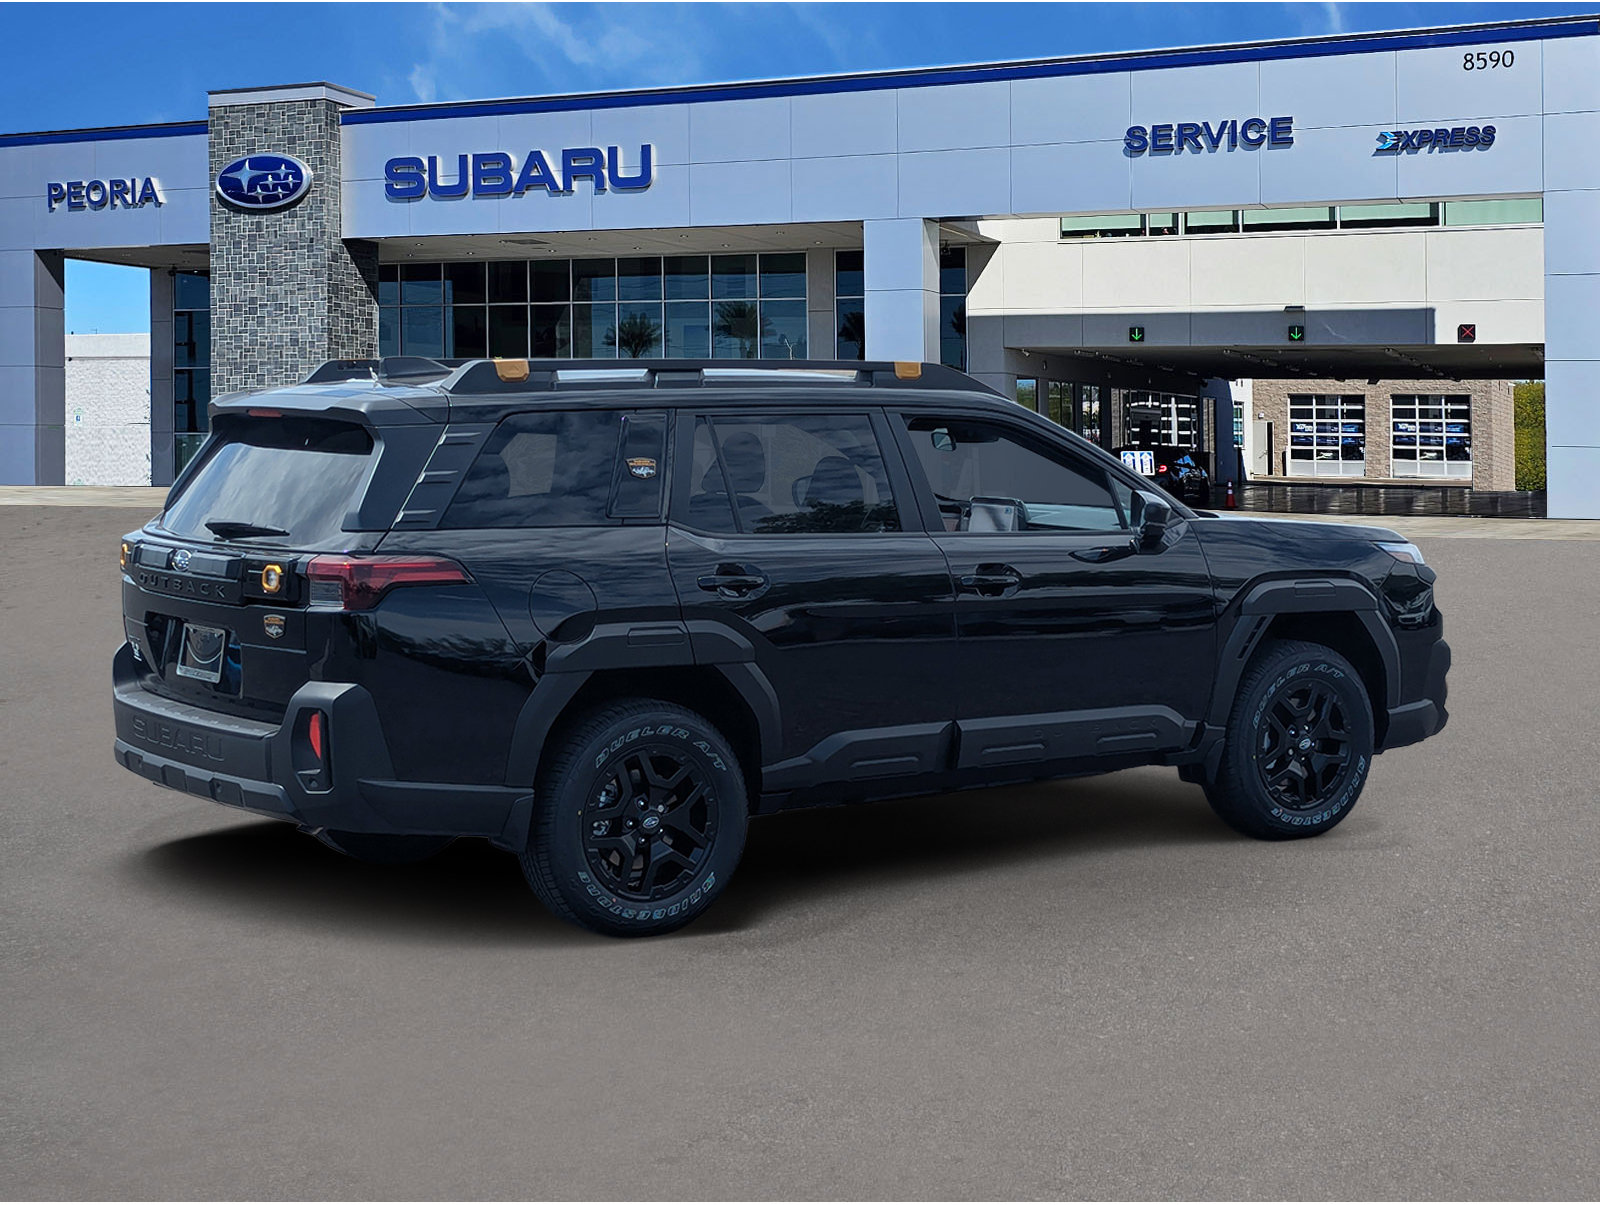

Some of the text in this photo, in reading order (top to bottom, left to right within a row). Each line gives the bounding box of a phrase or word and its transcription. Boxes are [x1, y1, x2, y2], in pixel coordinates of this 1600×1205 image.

[1463, 50, 1516, 72] 8590
[1125, 116, 1294, 152] SERVICE
[1376, 125, 1497, 151] EXPRESS
[384, 143, 653, 199] SUBARU
[47, 176, 162, 210] PEORIA
[139, 572, 225, 598] OUTBACK
[132, 715, 225, 761] SUBARU
[595, 725, 727, 771] DUELER A/T
[577, 871, 717, 921] BRIDGESTONE
